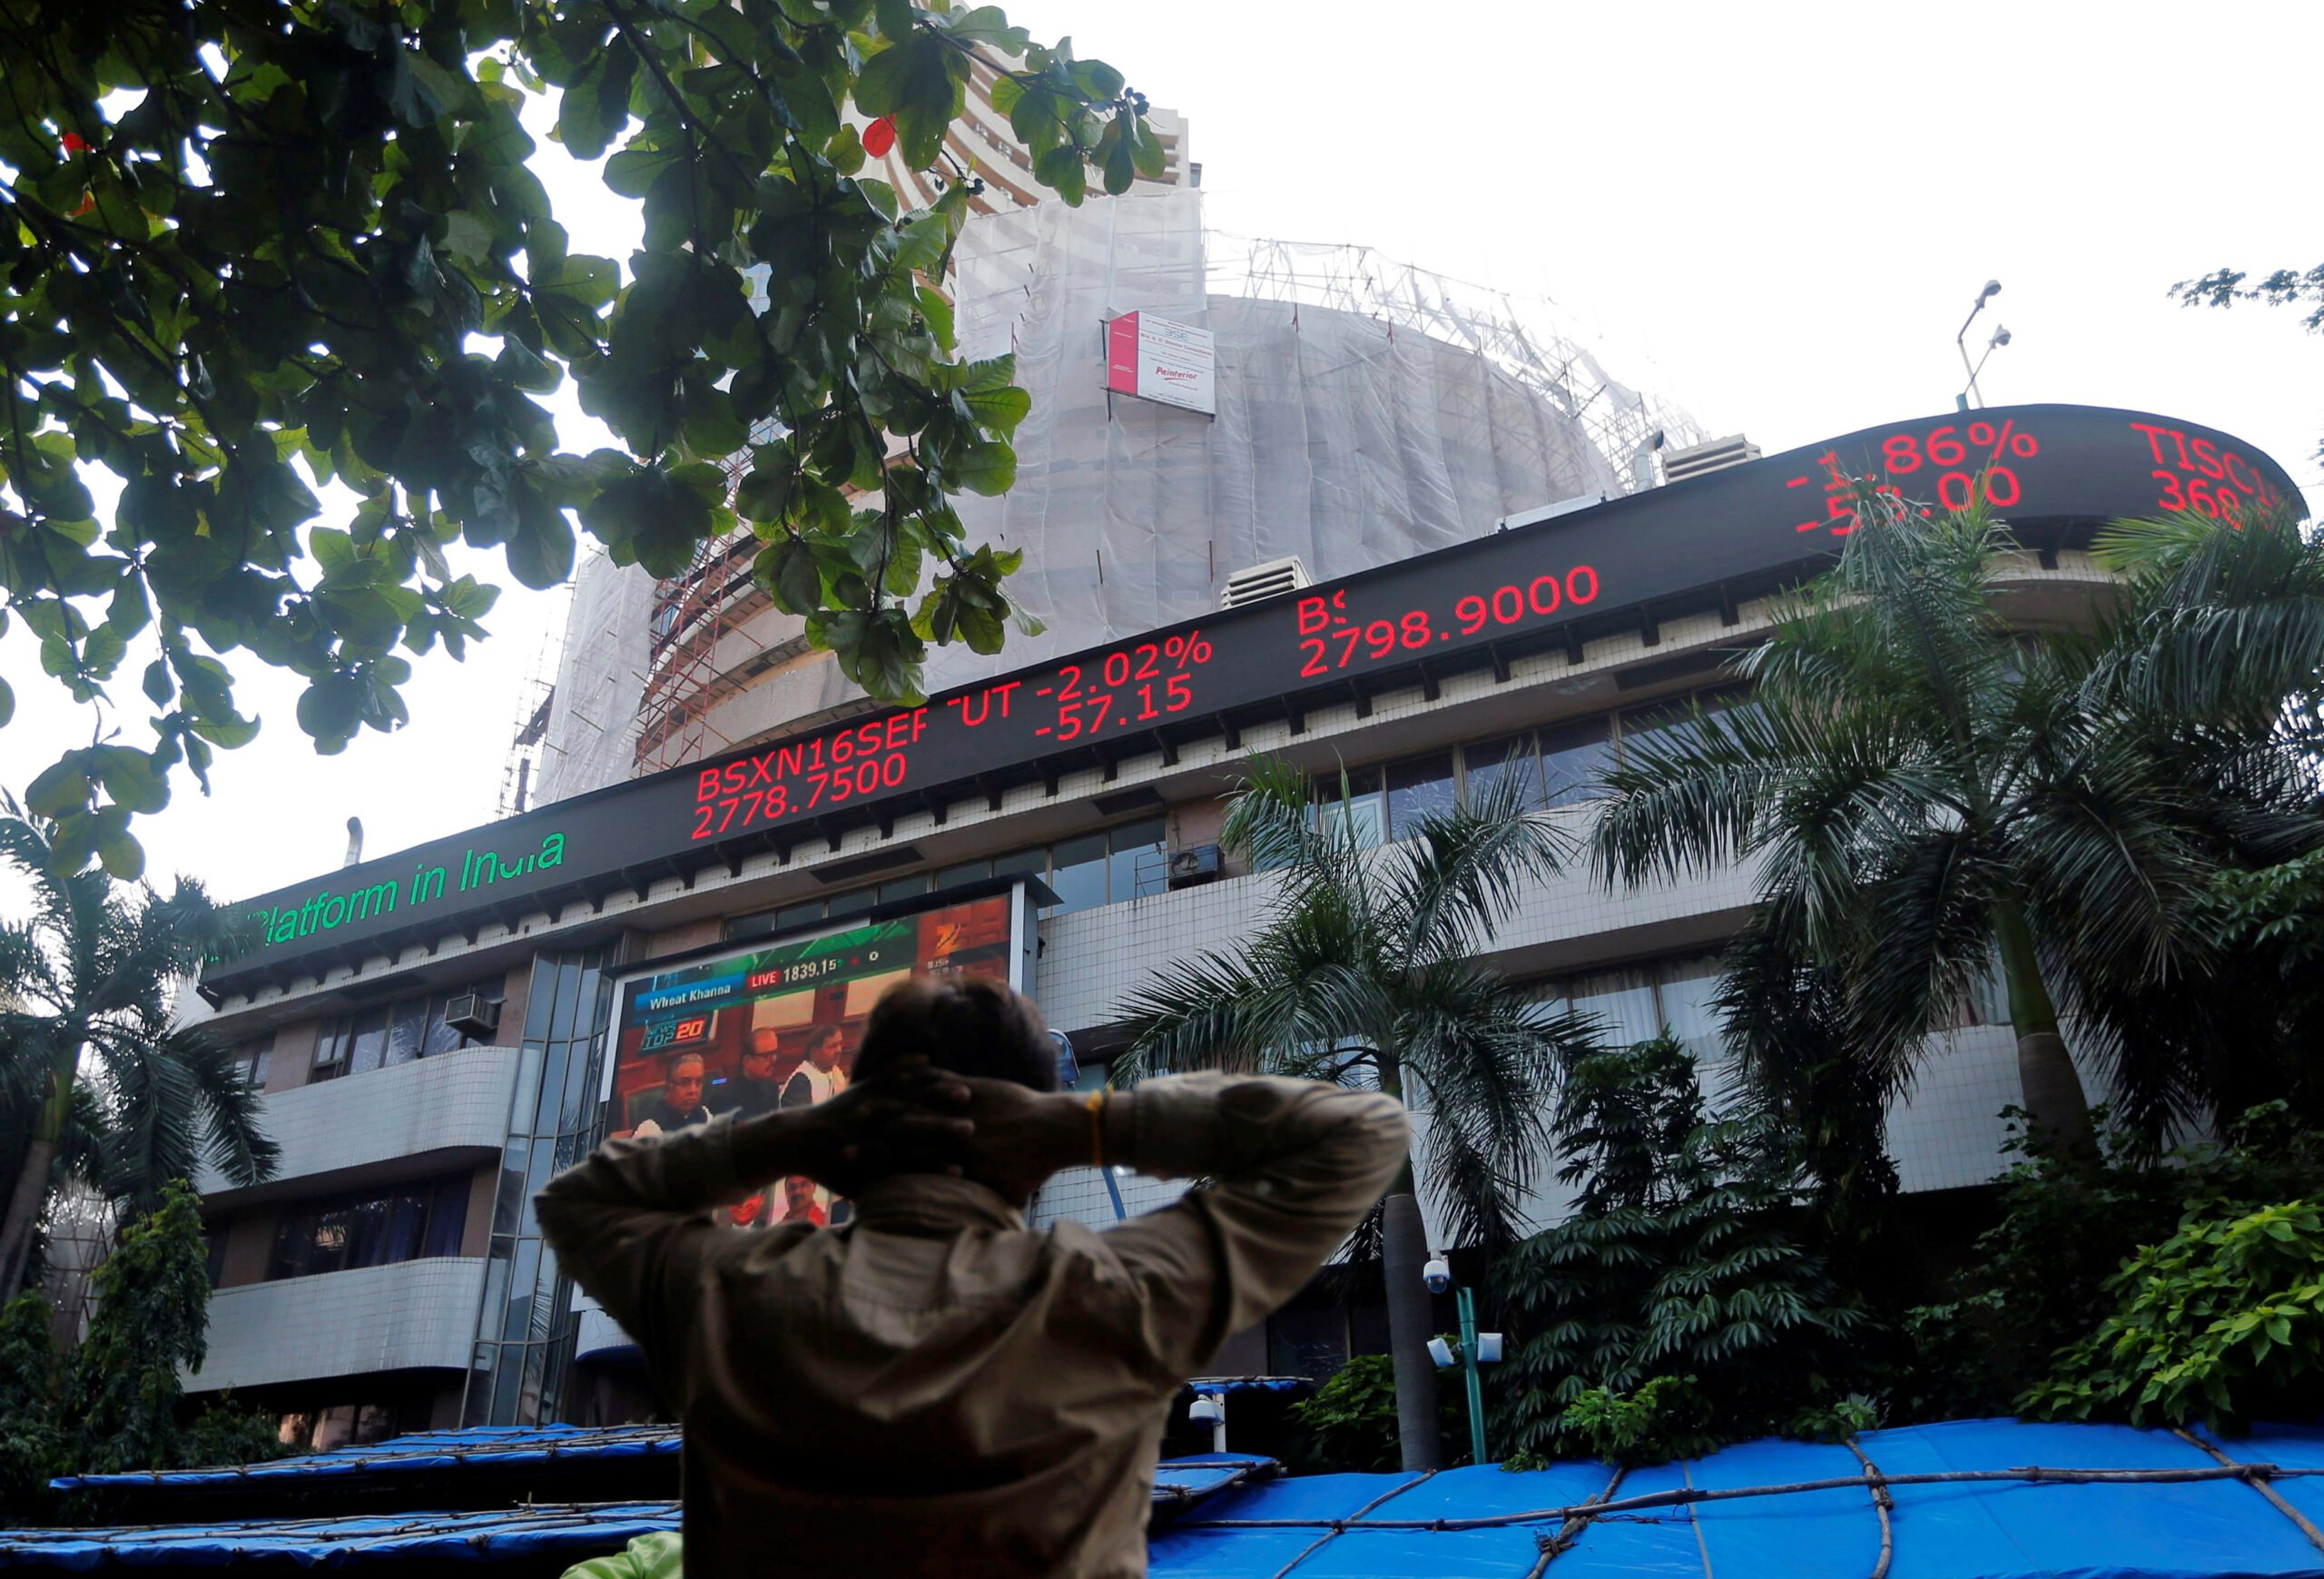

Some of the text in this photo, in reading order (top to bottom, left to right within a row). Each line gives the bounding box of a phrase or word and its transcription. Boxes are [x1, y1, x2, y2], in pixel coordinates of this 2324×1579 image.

[1156, 366, 1197, 380] Painterior
[1298, 565, 1600, 678] 2798.9000
[1035, 629, 1214, 704] -2.02%
[691, 673, 1193, 841] 2778.7500 -57.15
[409, 863, 447, 905] in
[650, 993, 687, 1011] Wheat
[689, 984, 732, 1002] Khanna
[752, 971, 777, 988] LIVE
[783, 959, 837, 983] 1839.15
[645, 1020, 705, 1048] TOP 20
